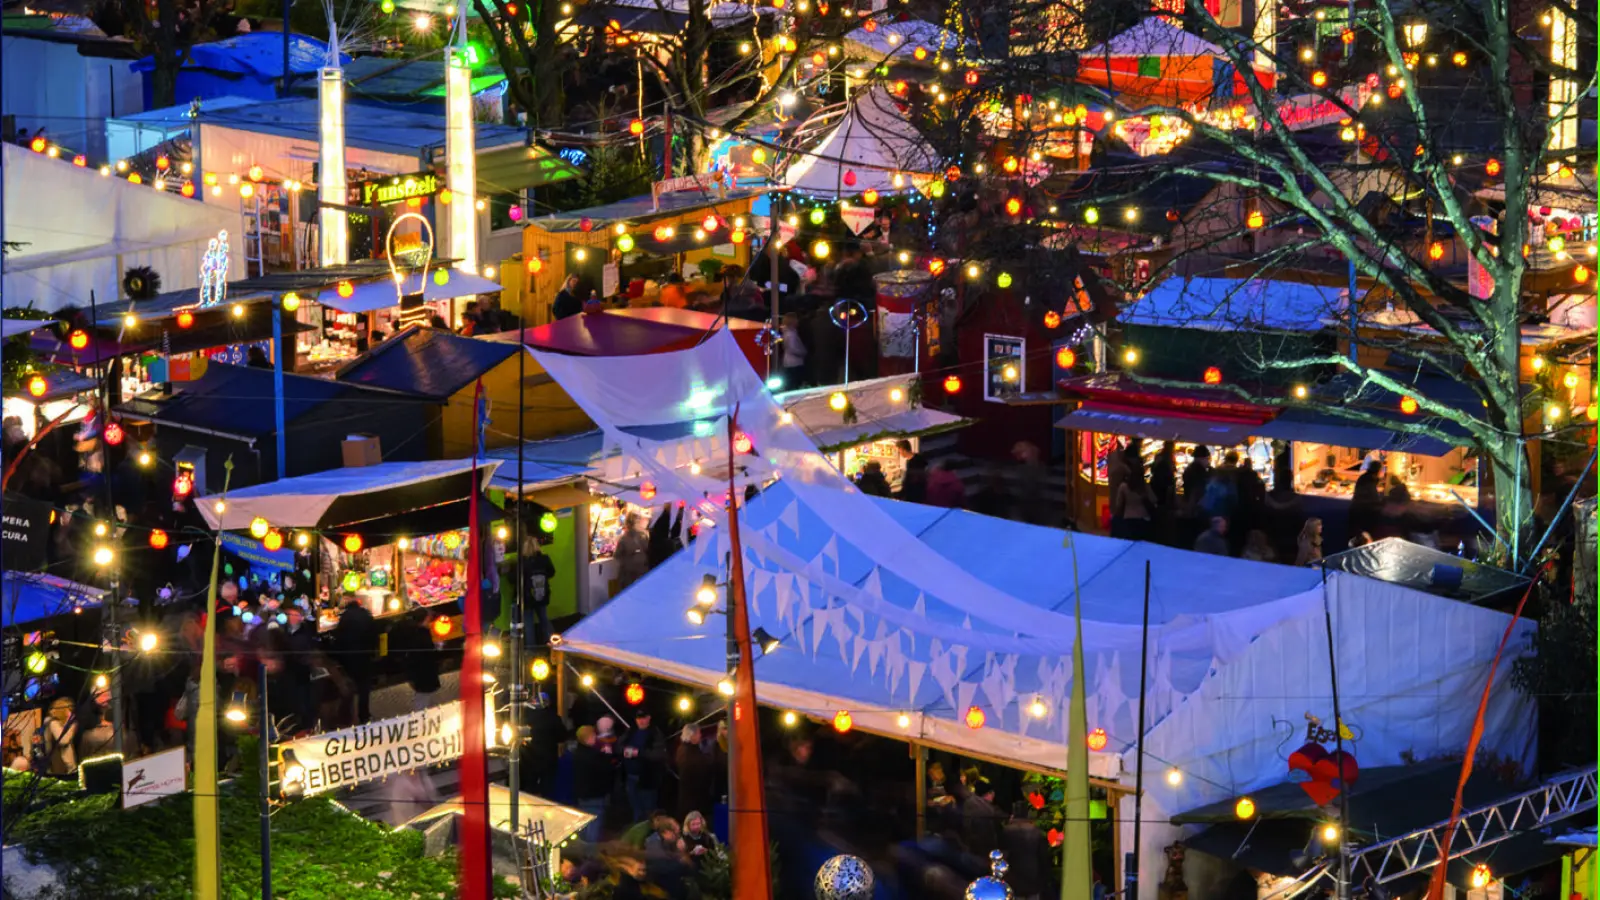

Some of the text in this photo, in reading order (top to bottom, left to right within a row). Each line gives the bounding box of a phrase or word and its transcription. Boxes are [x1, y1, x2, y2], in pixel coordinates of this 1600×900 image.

[363, 175, 437, 204] Kunstzelt
[2, 515, 31, 528] MERA
[2, 530, 29, 543] CURA
